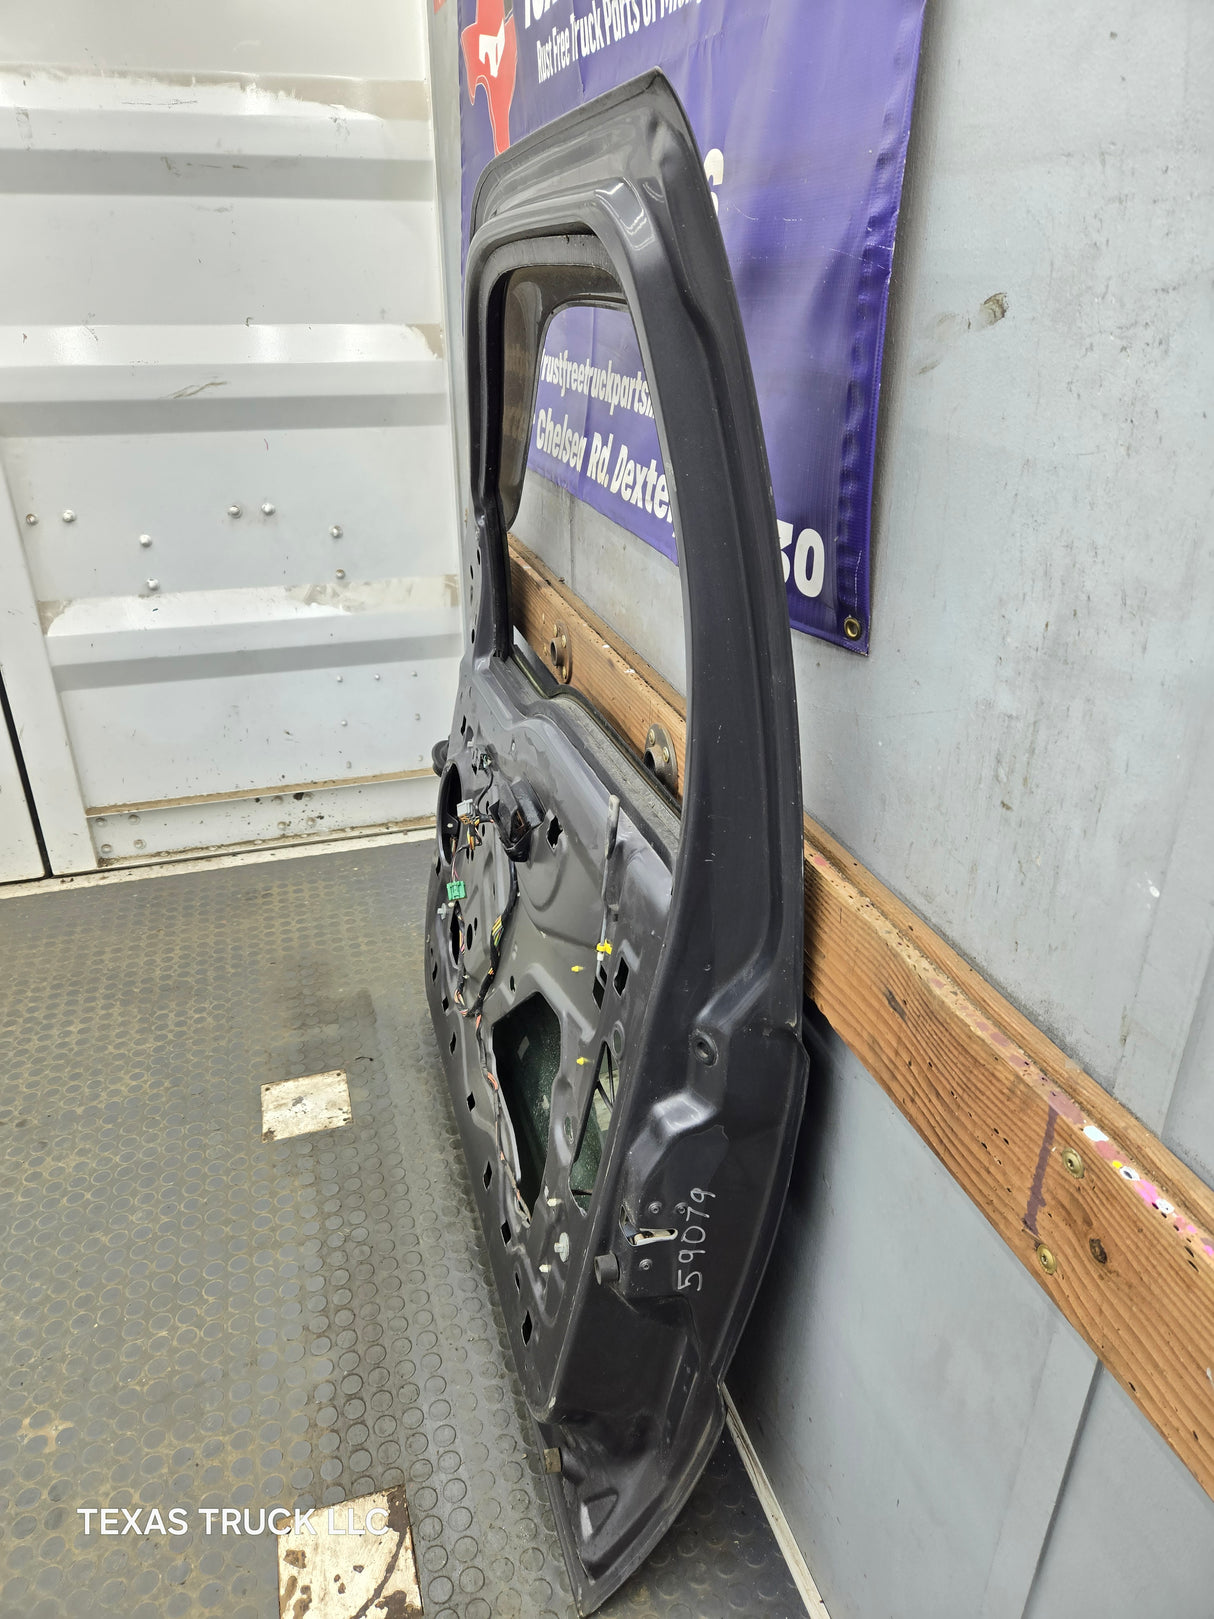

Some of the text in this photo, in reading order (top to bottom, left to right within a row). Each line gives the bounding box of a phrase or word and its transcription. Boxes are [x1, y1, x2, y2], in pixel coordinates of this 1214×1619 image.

[536, 40, 554, 84] Rust
[552, 26, 570, 74] Free
[569, 1, 605, 61] Truck
[602, 0, 640, 46] Parts
[539, 348, 655, 419] rustfreetruckparts
[536, 407, 673, 524] Chelsea Rd. Dexte
[677, 1187, 716, 1292] 59079
